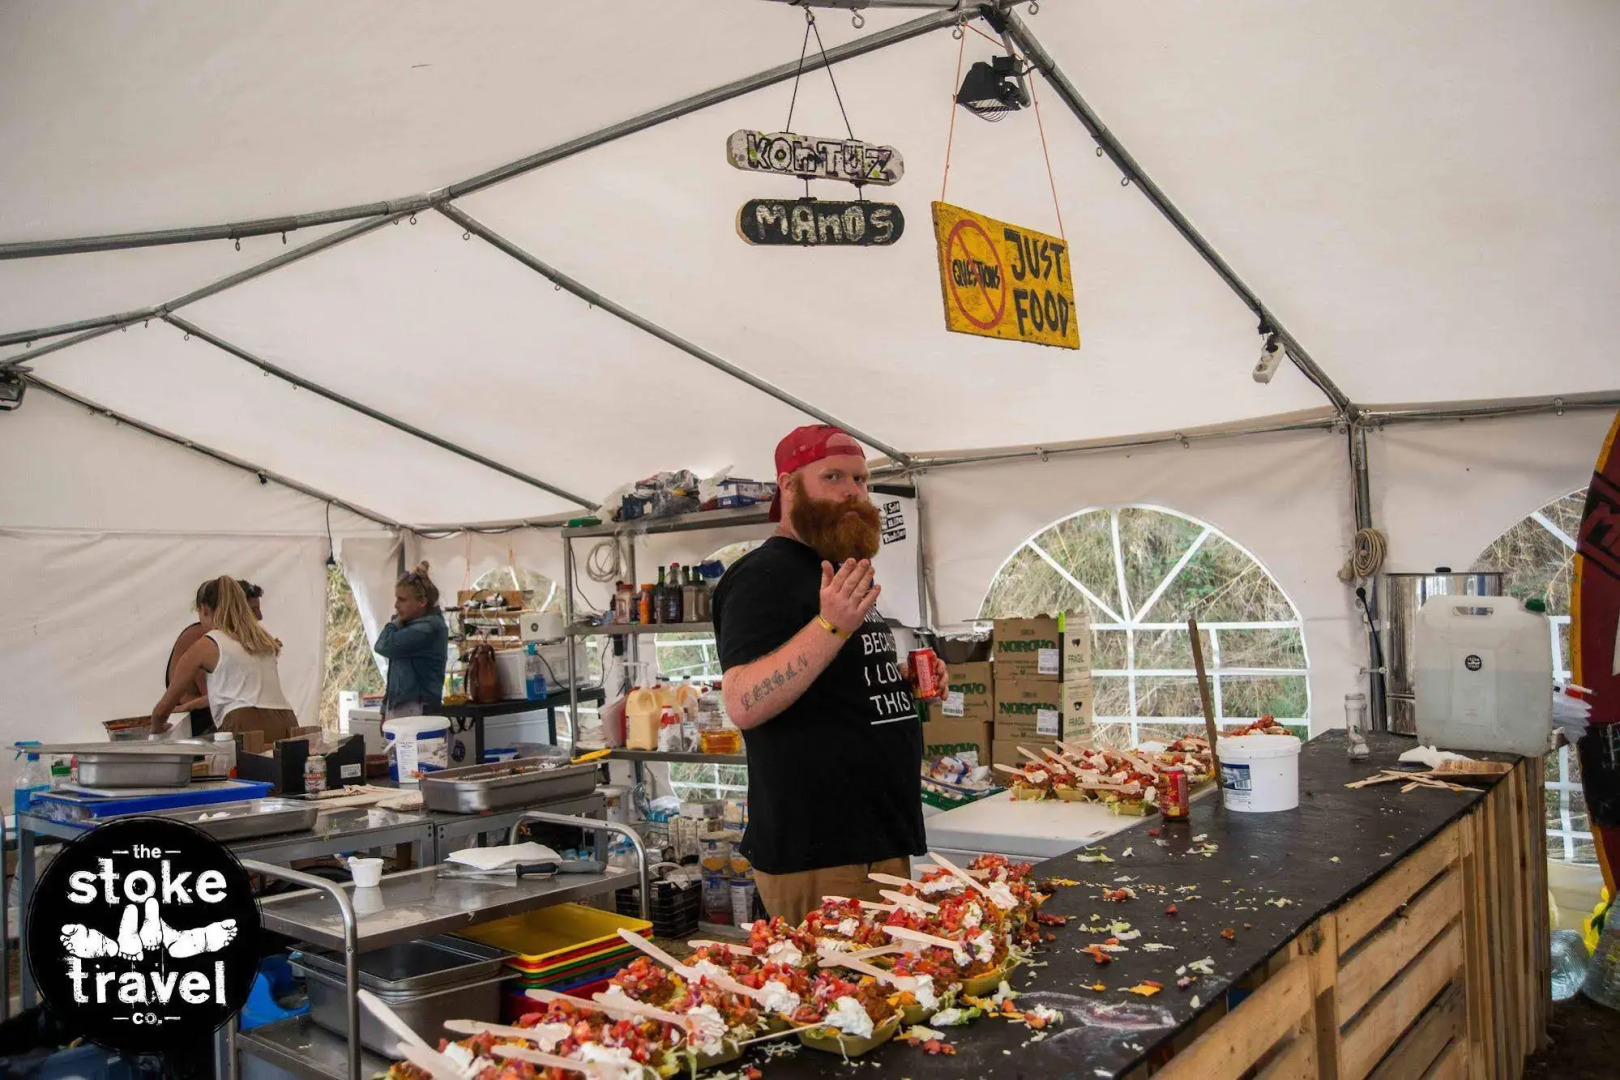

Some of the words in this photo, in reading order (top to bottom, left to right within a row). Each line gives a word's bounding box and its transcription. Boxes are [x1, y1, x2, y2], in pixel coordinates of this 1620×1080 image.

[1003, 227, 1065, 283] JUST
[1012, 287, 1069, 338] FOOD
[864, 666, 871, 687] I
[869, 690, 911, 716] THIS
